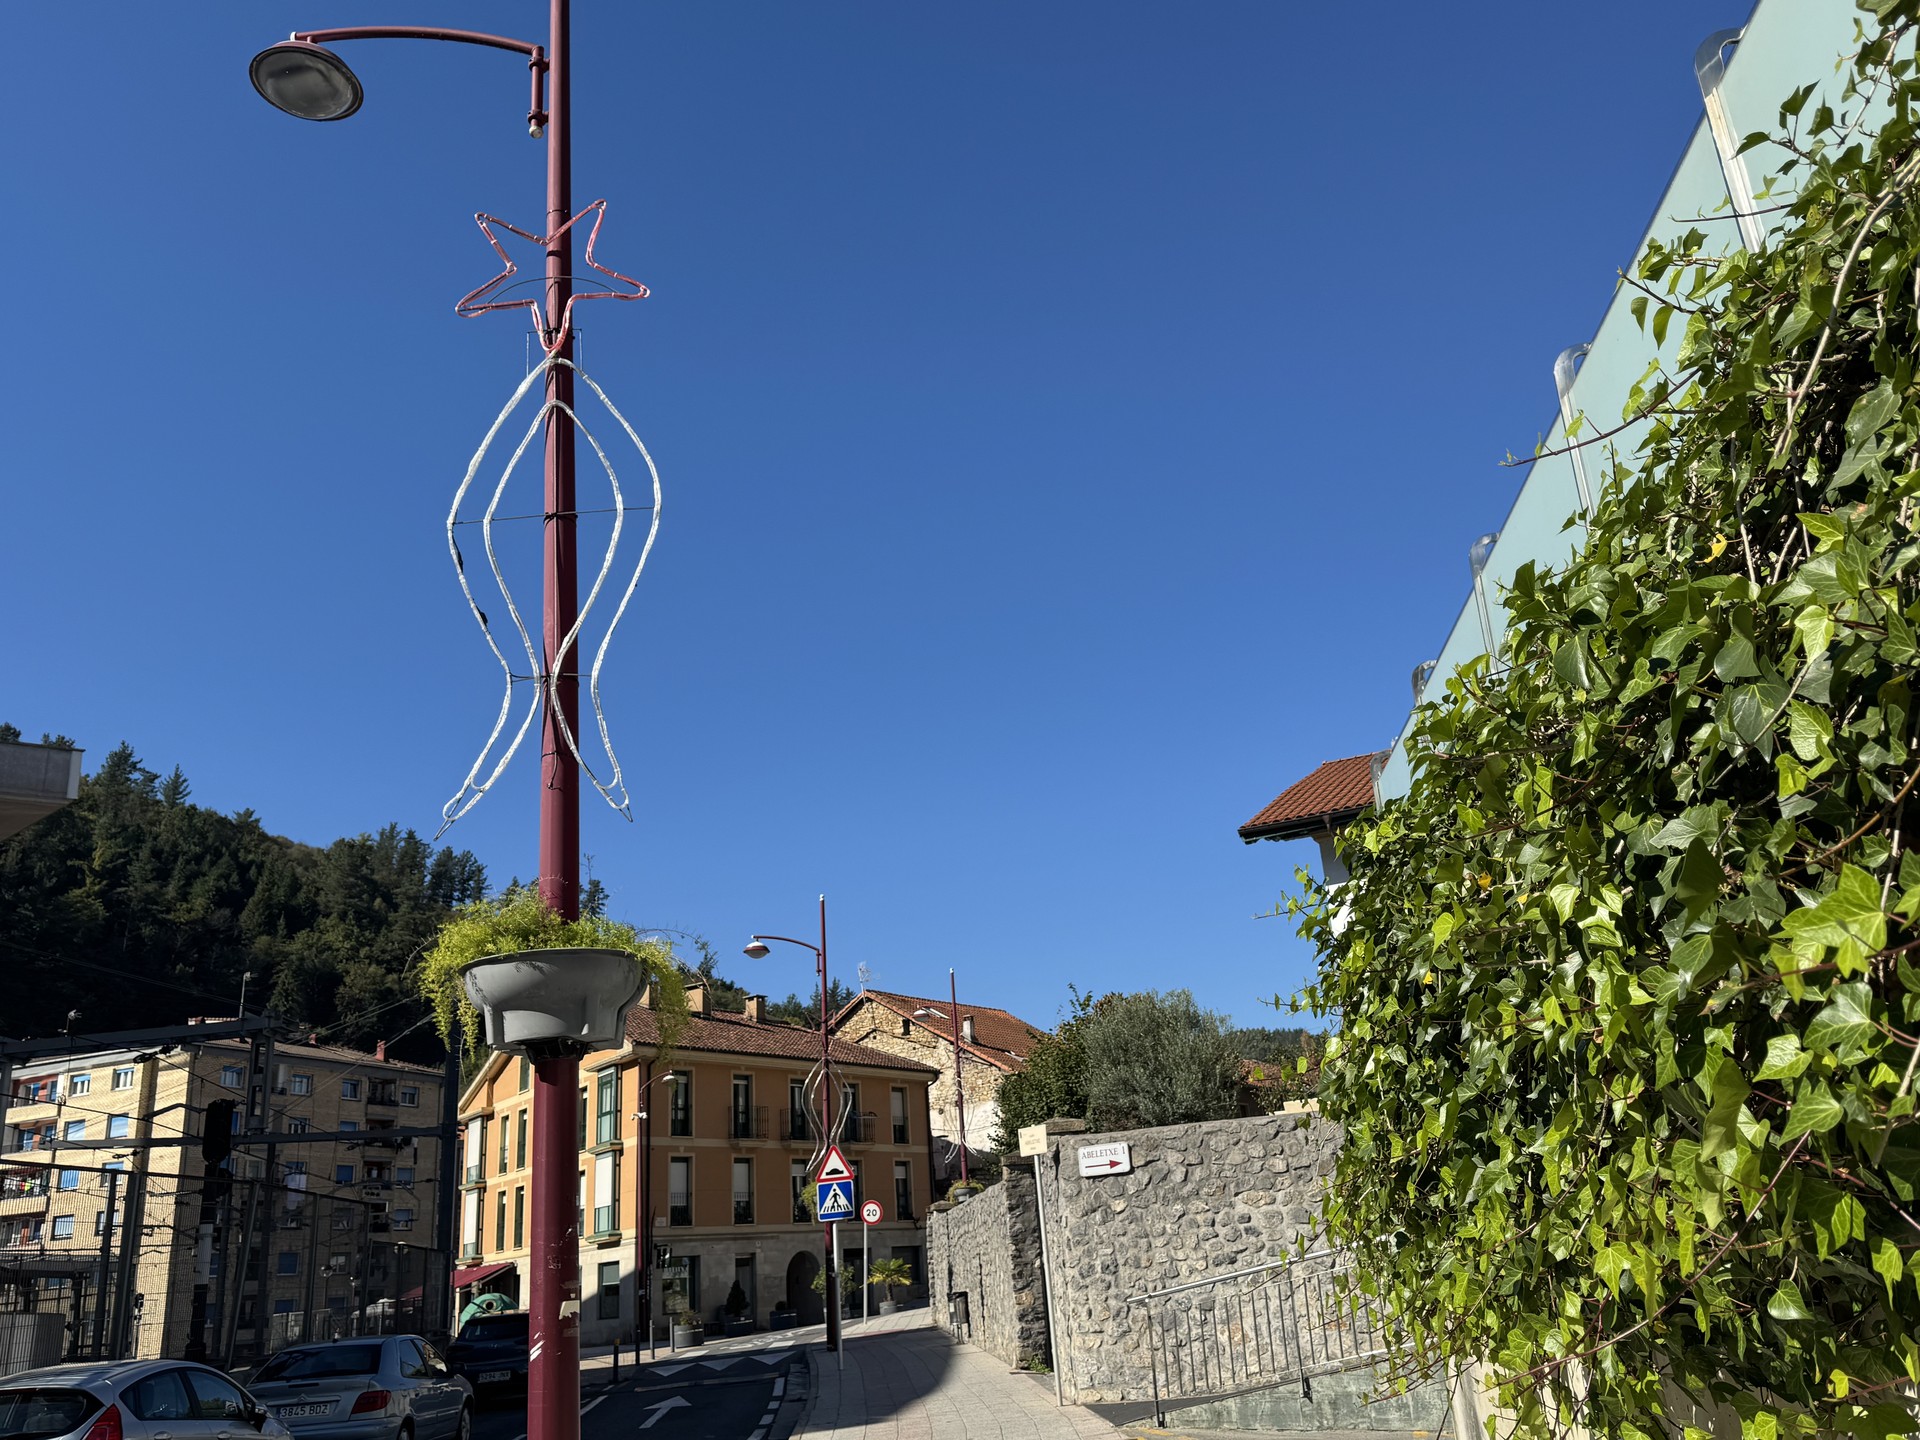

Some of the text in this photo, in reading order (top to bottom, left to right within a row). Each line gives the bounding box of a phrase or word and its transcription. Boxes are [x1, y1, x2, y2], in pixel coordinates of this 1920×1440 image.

[1081, 1147, 1118, 1159] ABELETXE
[866, 1208, 877, 1217] 20
[281, 1404, 328, 1417] 3845 BDZ
